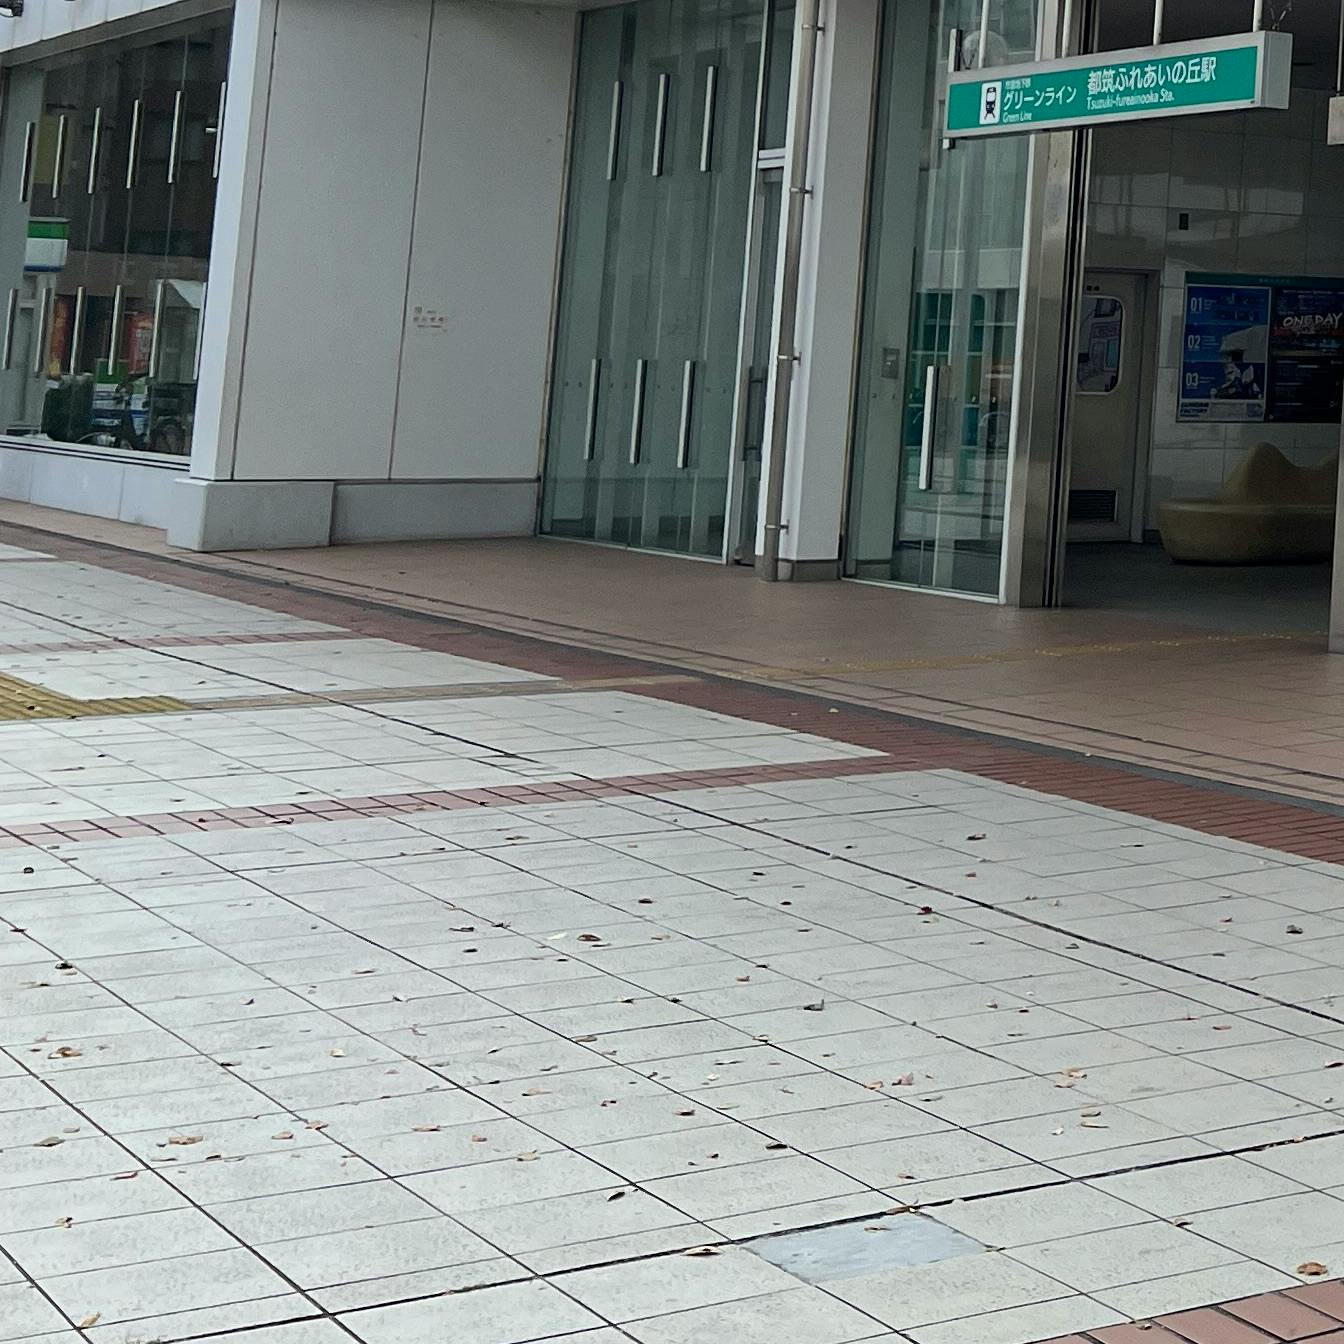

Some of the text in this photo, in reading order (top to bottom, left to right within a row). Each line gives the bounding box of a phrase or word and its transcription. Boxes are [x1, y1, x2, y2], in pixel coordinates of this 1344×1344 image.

[1087, 56, 1217, 96] 都筑ふれあいの丘駅
[1003, 85, 1077, 111] グリーンライン
[1190, 297, 1202, 312] 01
[1282, 311, 1343, 329] ONE DAY
[1188, 335, 1201, 350] 02
[1186, 372, 1199, 387] 03
